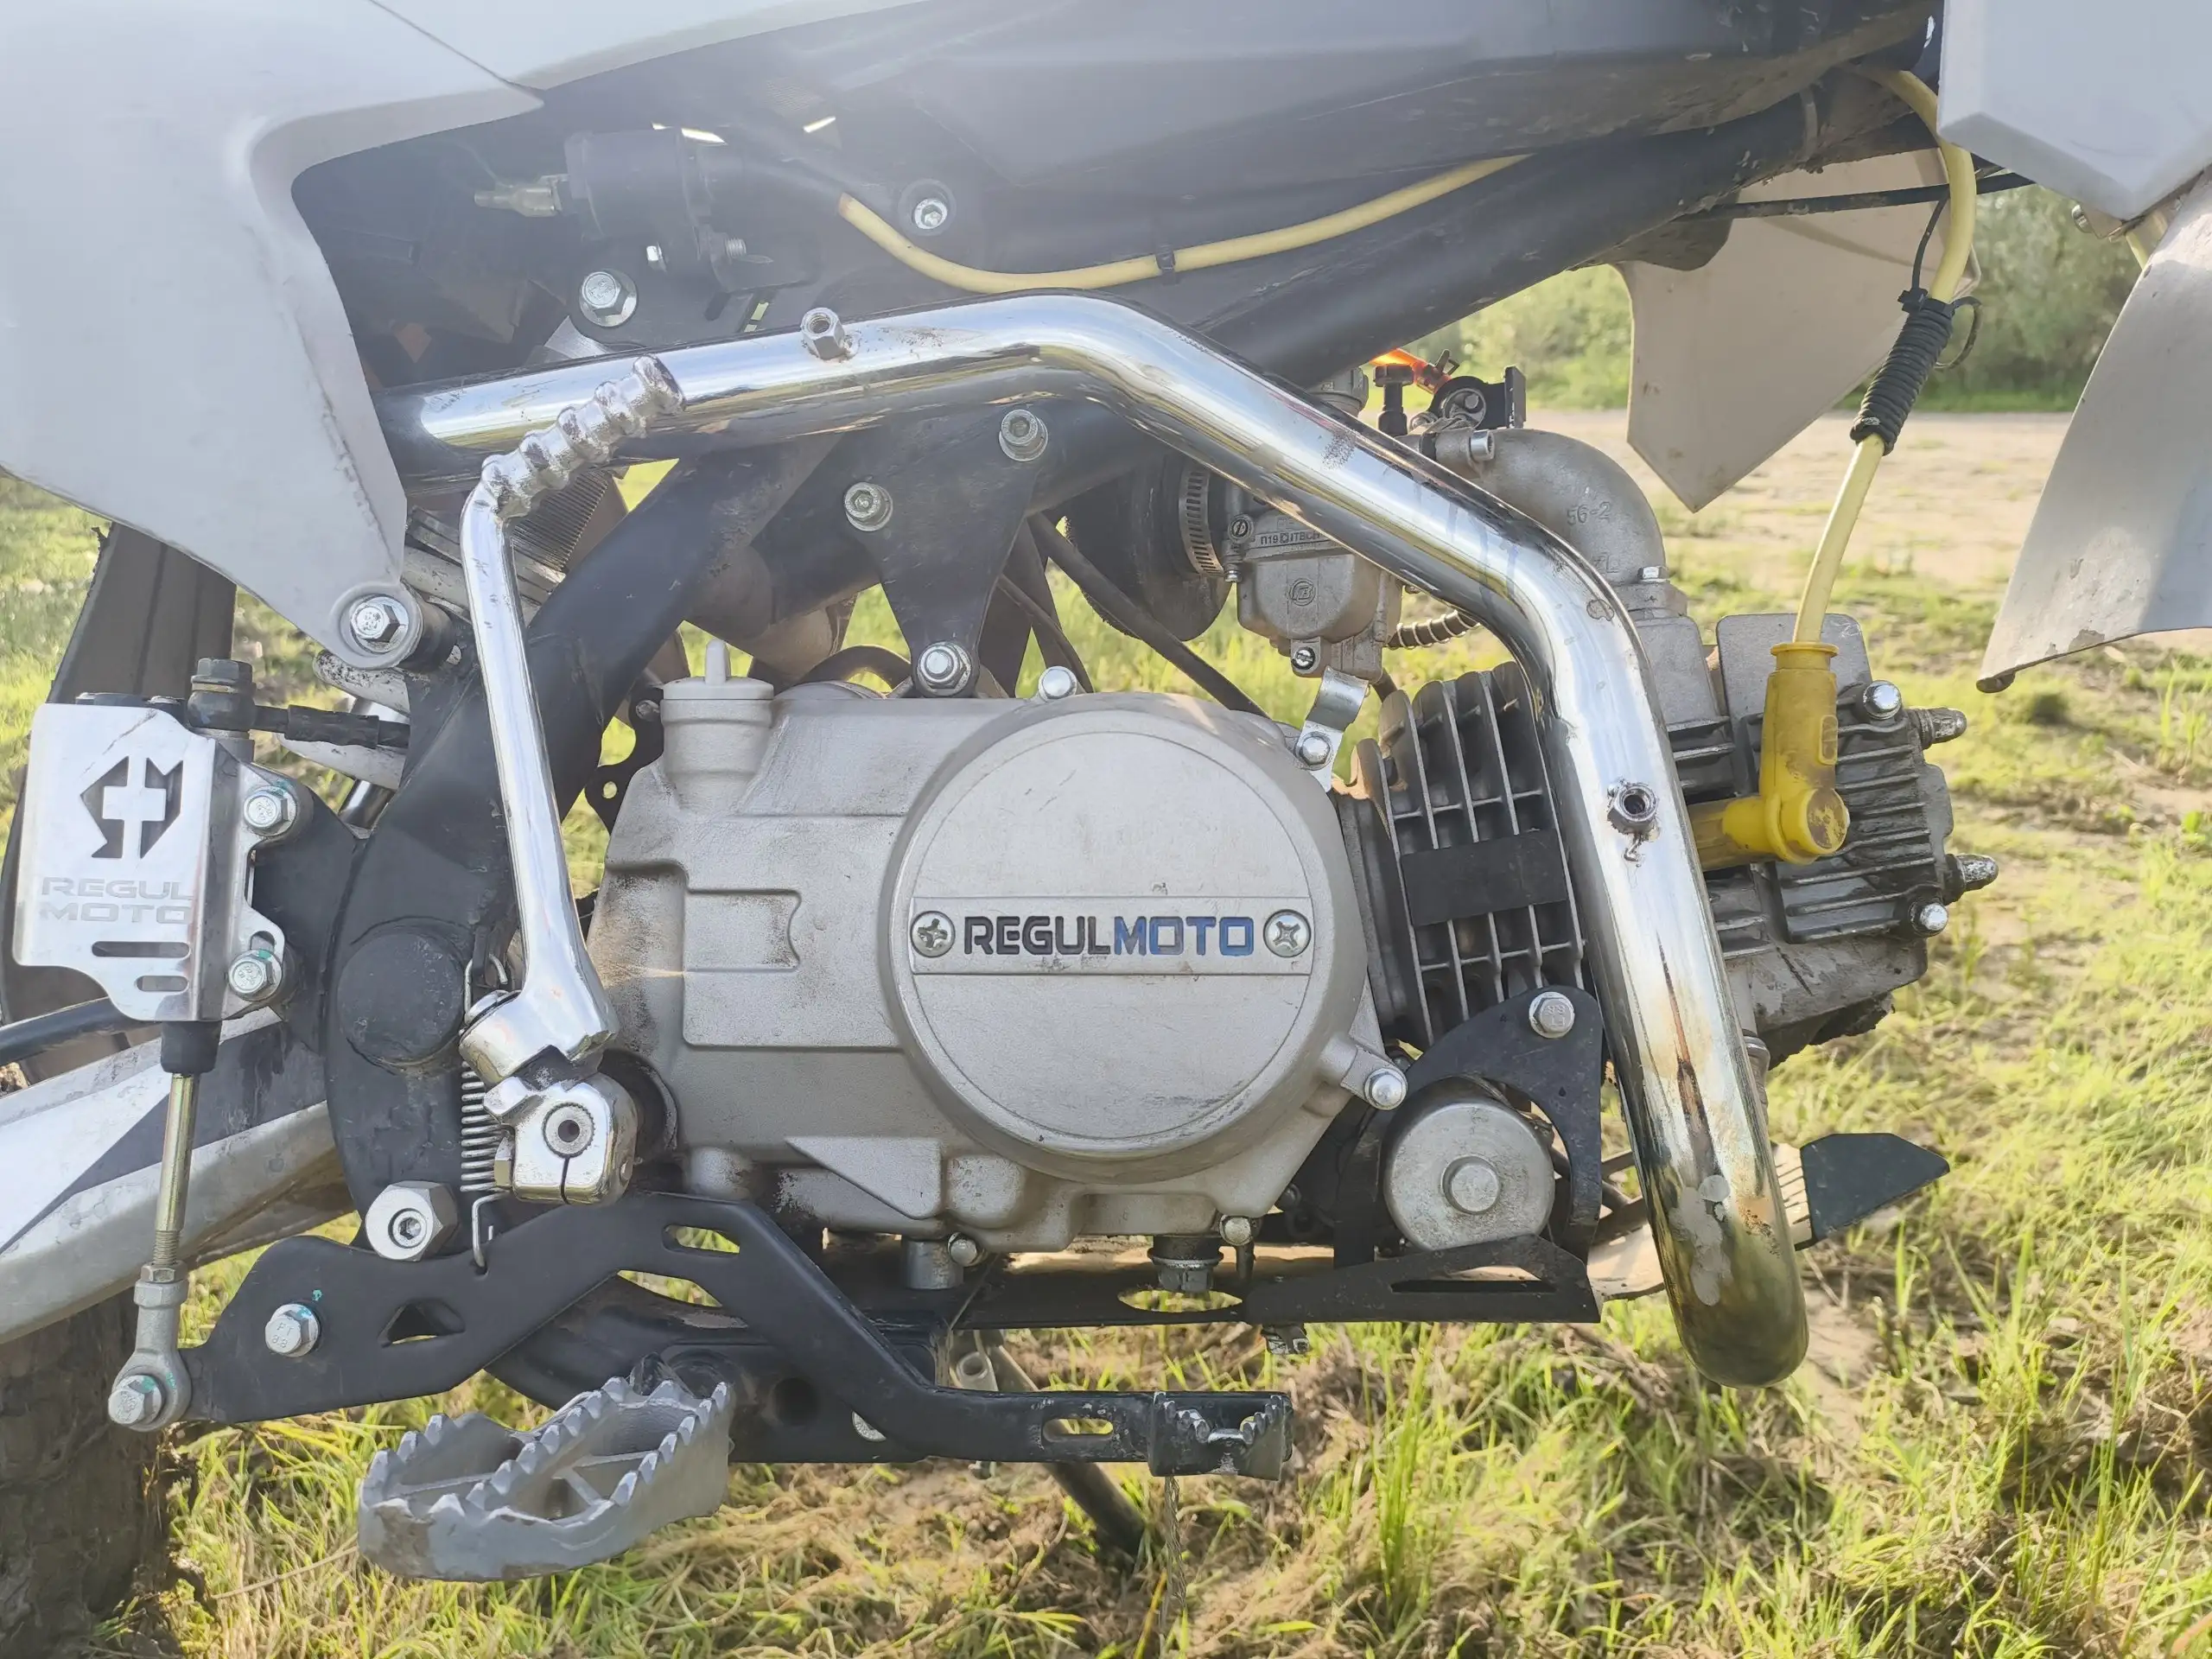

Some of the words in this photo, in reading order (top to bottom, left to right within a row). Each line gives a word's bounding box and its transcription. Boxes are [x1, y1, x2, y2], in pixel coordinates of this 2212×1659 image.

[41, 876, 194, 901] REGUL
[39, 902, 194, 925] MOTO
[963, 916, 1255, 956] REGULMOTO
